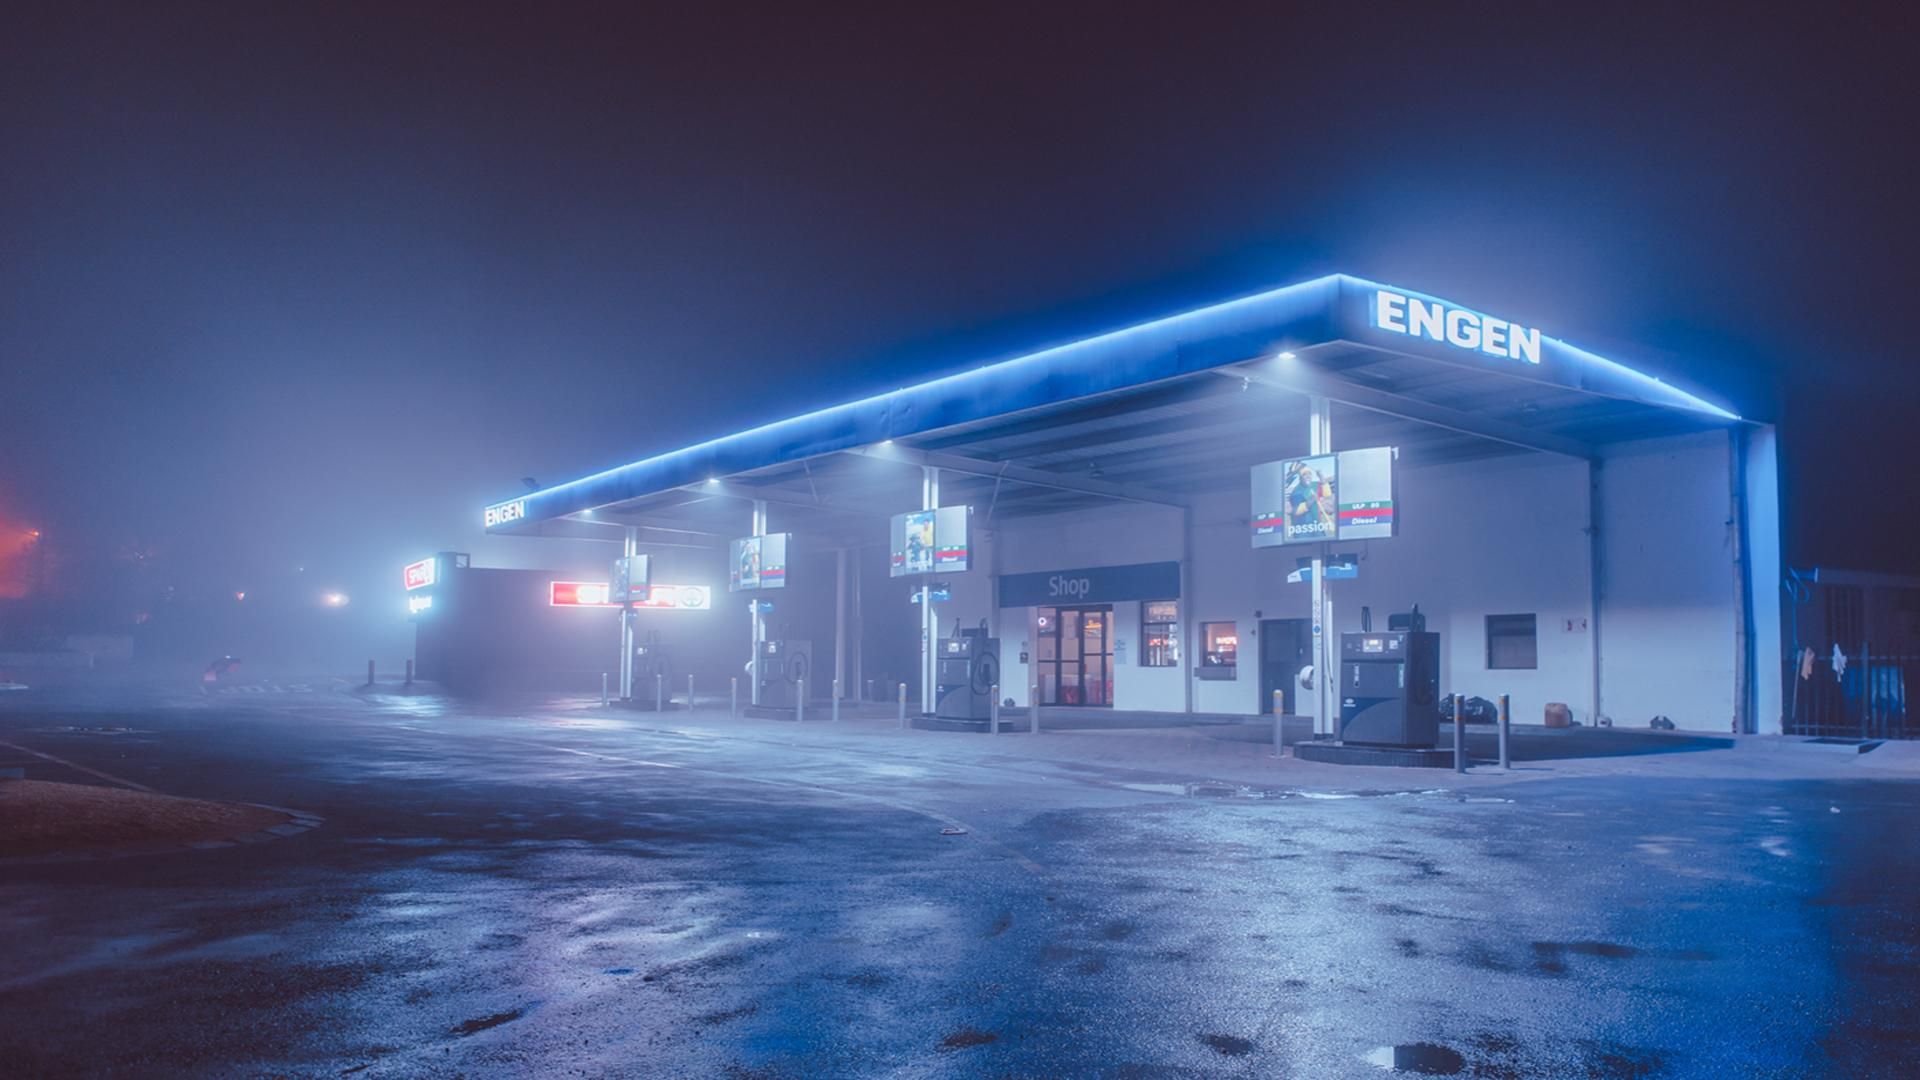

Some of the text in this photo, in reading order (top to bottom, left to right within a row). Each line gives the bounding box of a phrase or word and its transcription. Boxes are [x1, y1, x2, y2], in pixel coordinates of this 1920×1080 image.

[1377, 290, 1541, 365] ENGEN
[484, 499, 525, 528] ENGEN
[1288, 520, 1334, 537] passion
[1049, 575, 1090, 600] Shop
